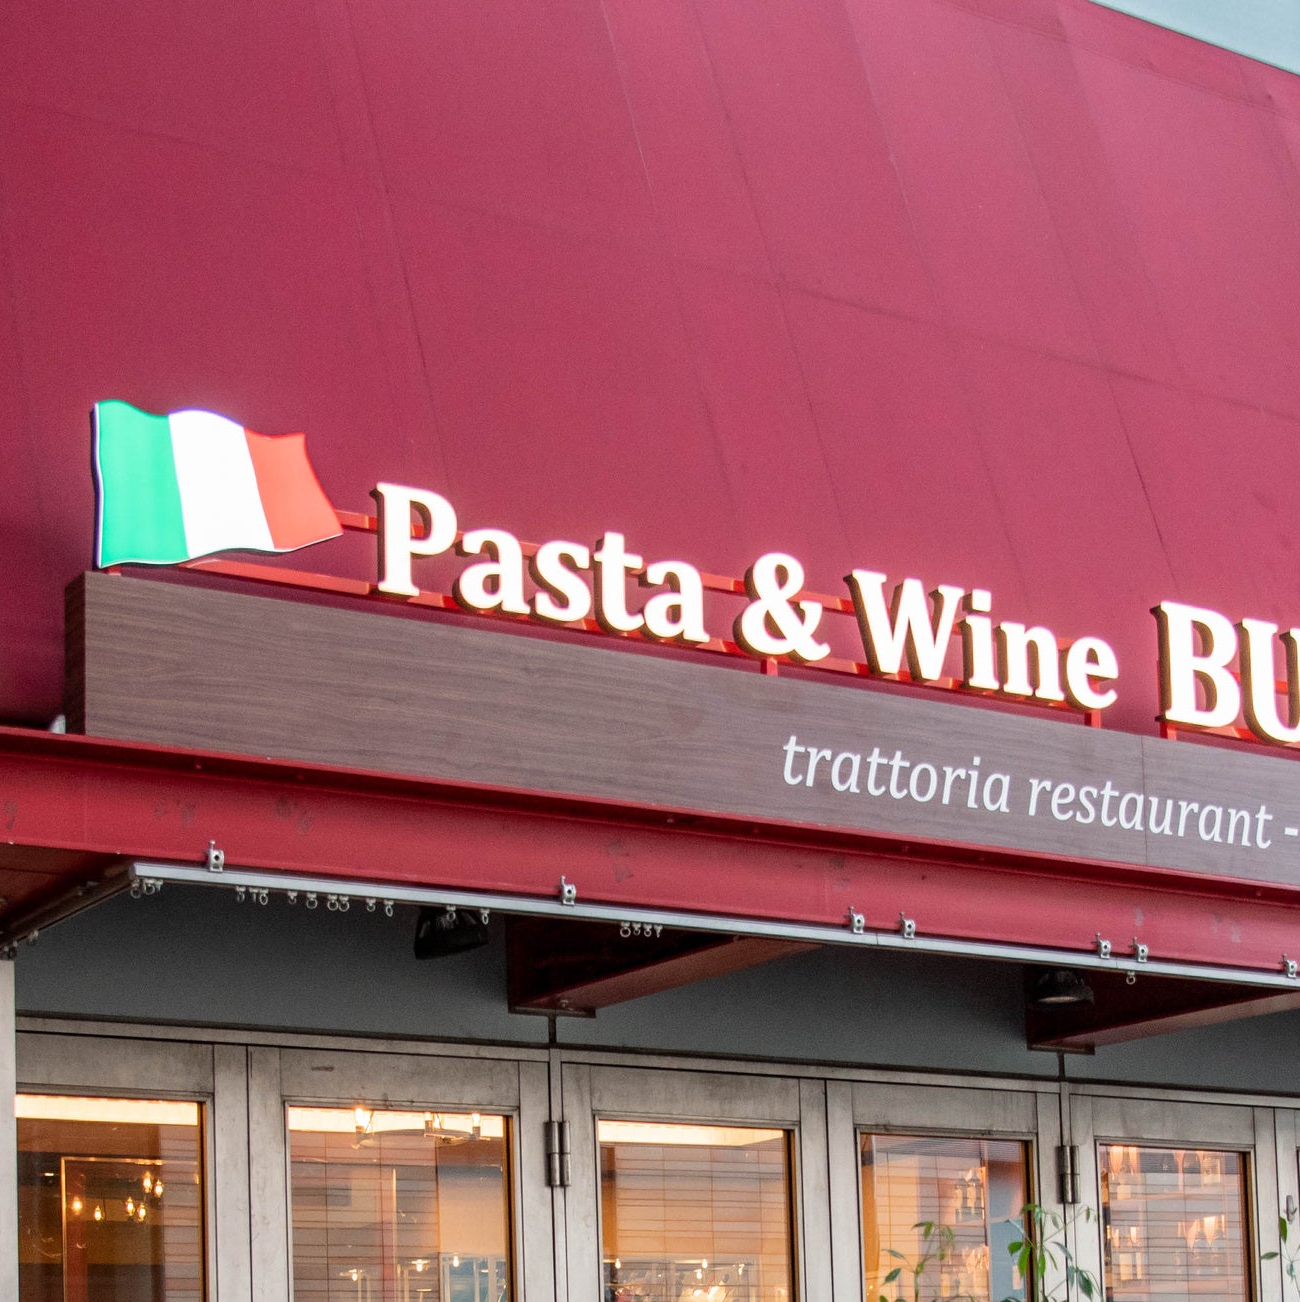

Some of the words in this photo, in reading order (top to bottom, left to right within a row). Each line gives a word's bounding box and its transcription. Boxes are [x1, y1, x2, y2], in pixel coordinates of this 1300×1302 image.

[374, 482, 710, 643] Pasta
[736, 552, 831, 661] &
[848, 569, 1119, 709] Wine
[782, 736, 1010, 812] trattoria
[1028, 777, 1273, 849] restaurant
